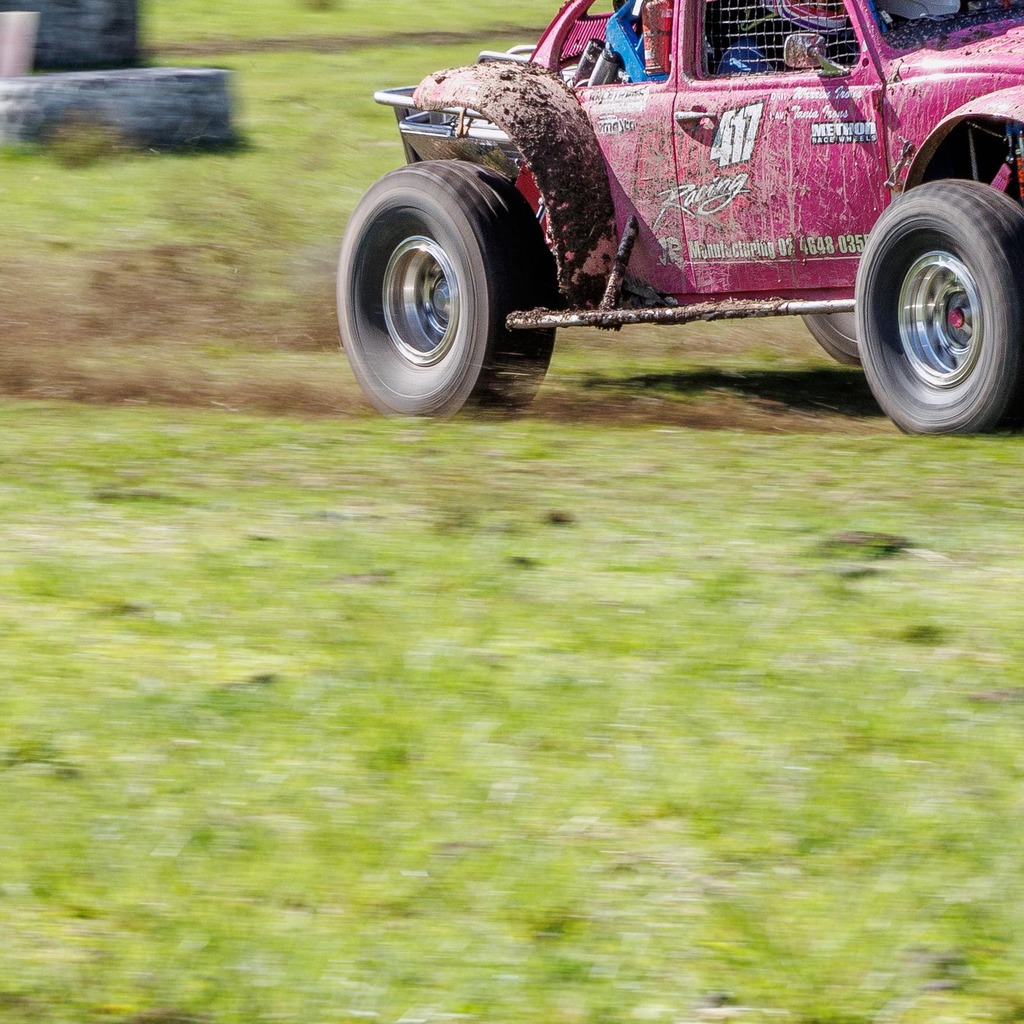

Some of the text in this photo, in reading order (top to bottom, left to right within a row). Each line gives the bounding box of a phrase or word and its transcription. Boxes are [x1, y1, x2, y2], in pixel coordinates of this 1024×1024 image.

[709, 100, 765, 168] 417
[811, 121, 877, 137] METHOD
[811, 134, 877, 144] RACE WHEELS
[652, 173, 751, 230] Racing
[687, 238, 776, 260] Manufacturing
[800, 235, 835, 256] 4648
